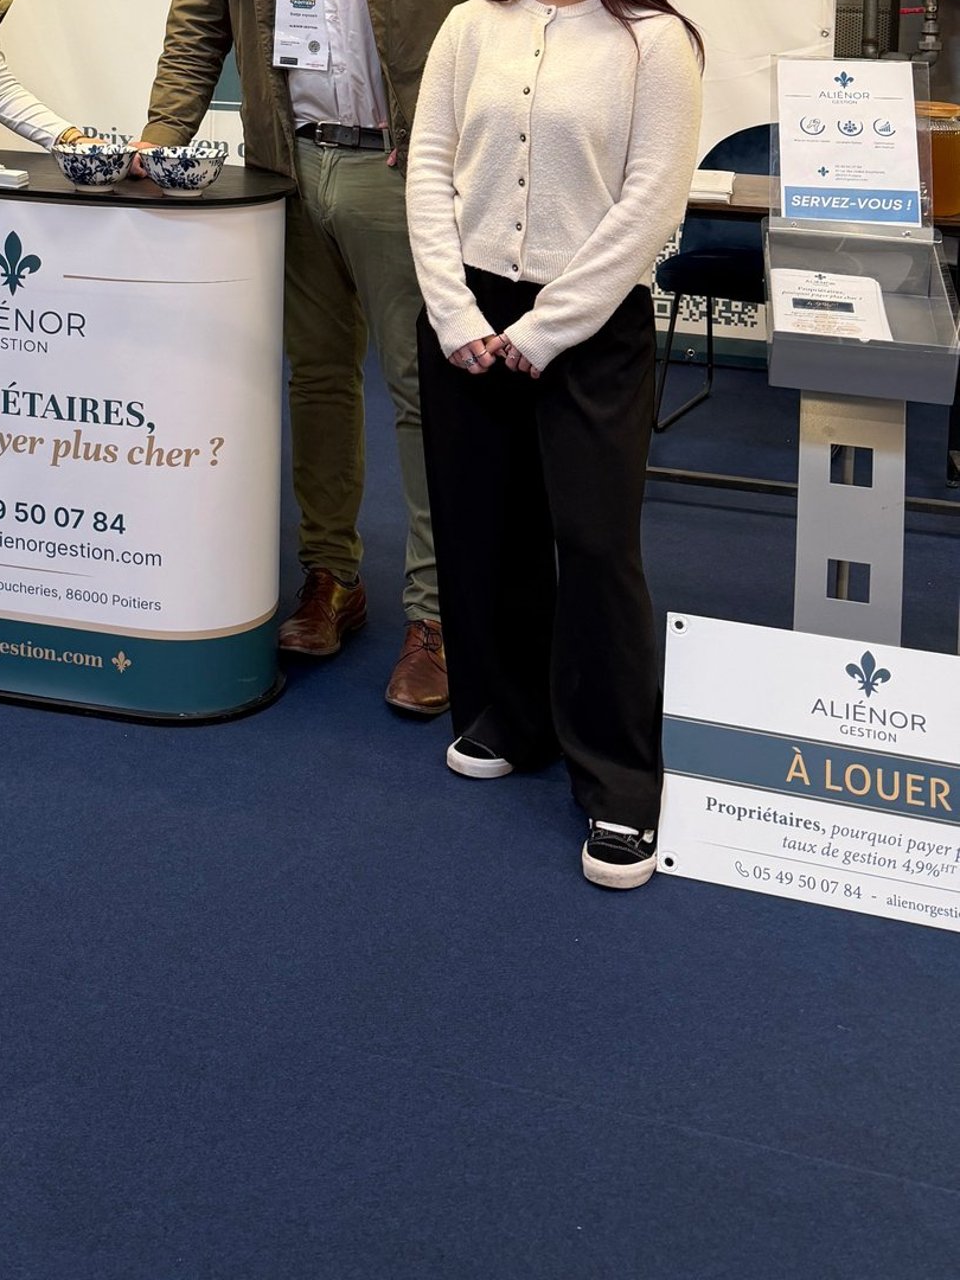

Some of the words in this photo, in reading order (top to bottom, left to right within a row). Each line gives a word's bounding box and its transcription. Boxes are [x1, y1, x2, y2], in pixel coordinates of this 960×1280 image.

[791, 194, 903, 211] SERVEZ-VOUS
[906, 199, 913, 211] !
[49, 428, 120, 468] plus
[127, 435, 201, 468] cher
[208, 436, 225, 467] ?
[14, 500, 47, 525] 50
[54, 505, 85, 530] 07
[92, 510, 127, 535] 84
[65, 586, 109, 606] 86000
[111, 593, 162, 613] Poitiers
[811, 698, 927, 734] ALIÉNOR
[839, 724, 898, 744] GESTION
[786, 746, 811, 786] À
[824, 759, 953, 812] LOUER
[705, 795, 827, 836] Propriétaires,
[830, 823, 903, 847] pourquoi
[906, 837, 952, 858] payer
[782, 835, 818, 855] taux
[820, 842, 840, 858] de
[842, 849, 898, 870] gestion
[753, 865, 772, 881] 05
[775, 869, 794, 885] 49
[798, 874, 816, 888] 50
[820, 880, 839, 895] 07
[843, 883, 863, 899] 84
